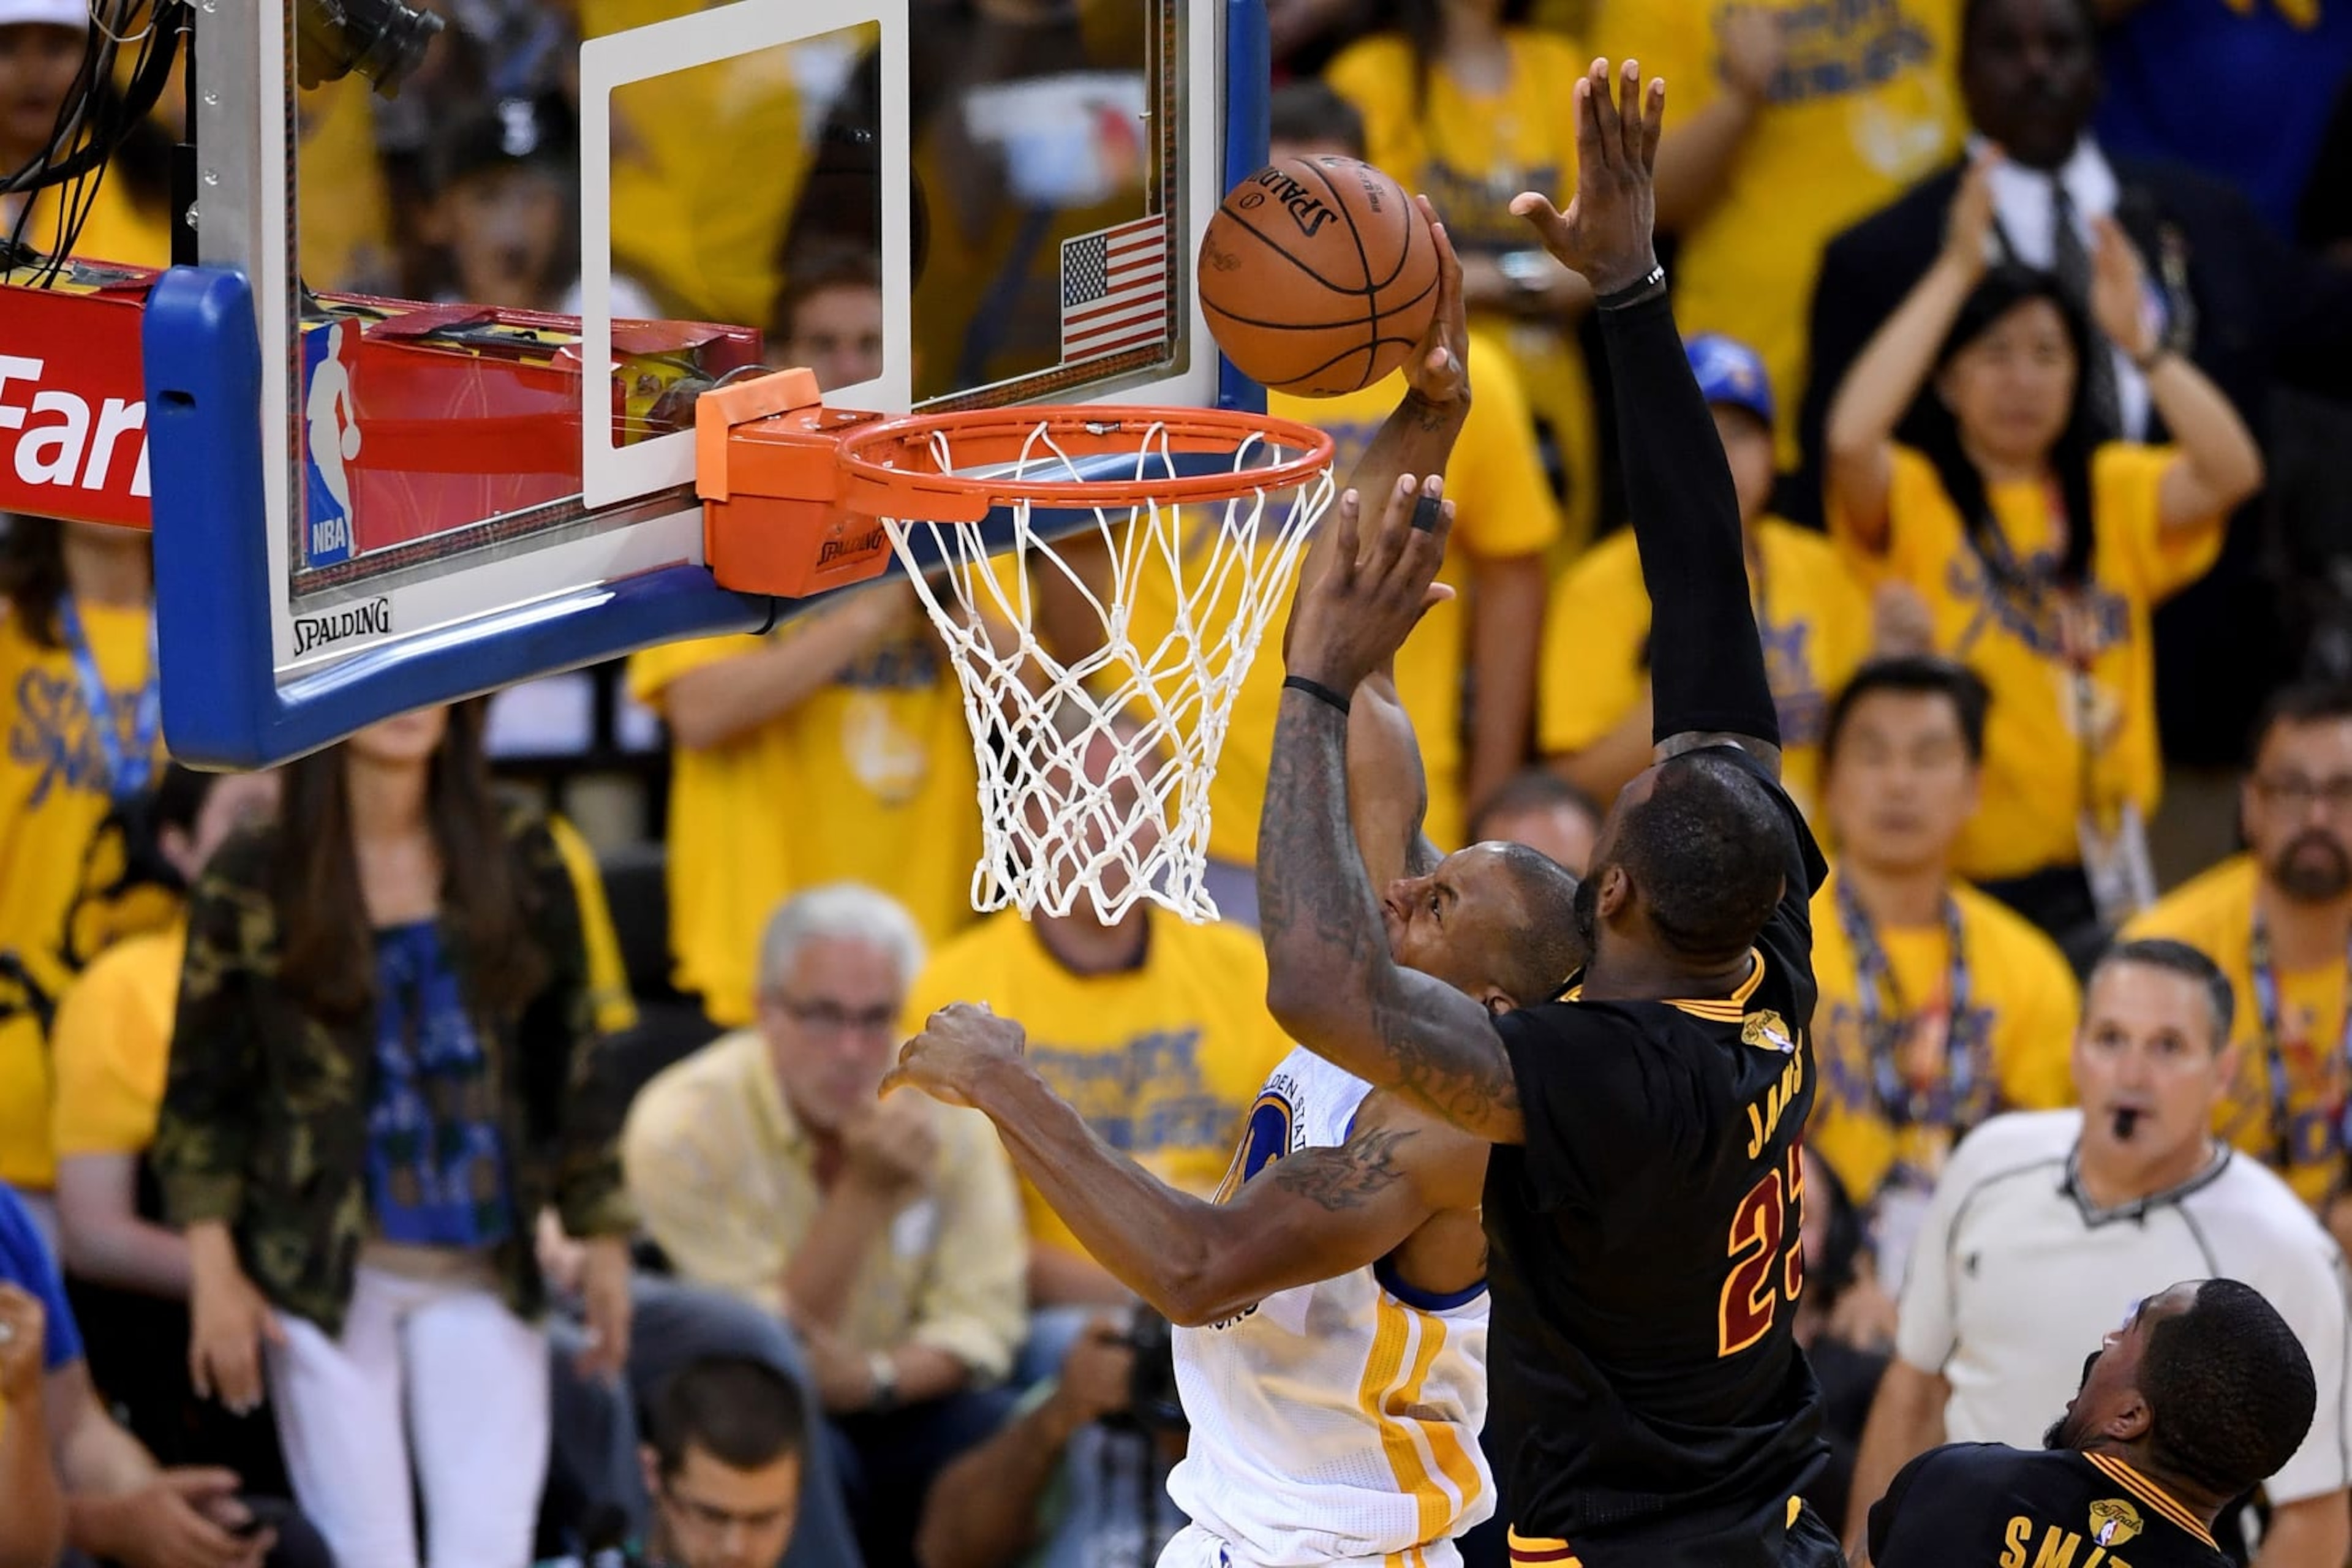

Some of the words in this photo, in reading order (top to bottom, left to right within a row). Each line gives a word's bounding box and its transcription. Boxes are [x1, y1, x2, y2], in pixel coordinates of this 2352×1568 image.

[0, 355, 152, 497] Far
[313, 517, 345, 555] NBA
[816, 527, 884, 567] SPALDING
[294, 598, 388, 657] SPALDING
[1294, 1096, 1306, 1150] STAT
[1999, 1516, 2133, 1568] SM
